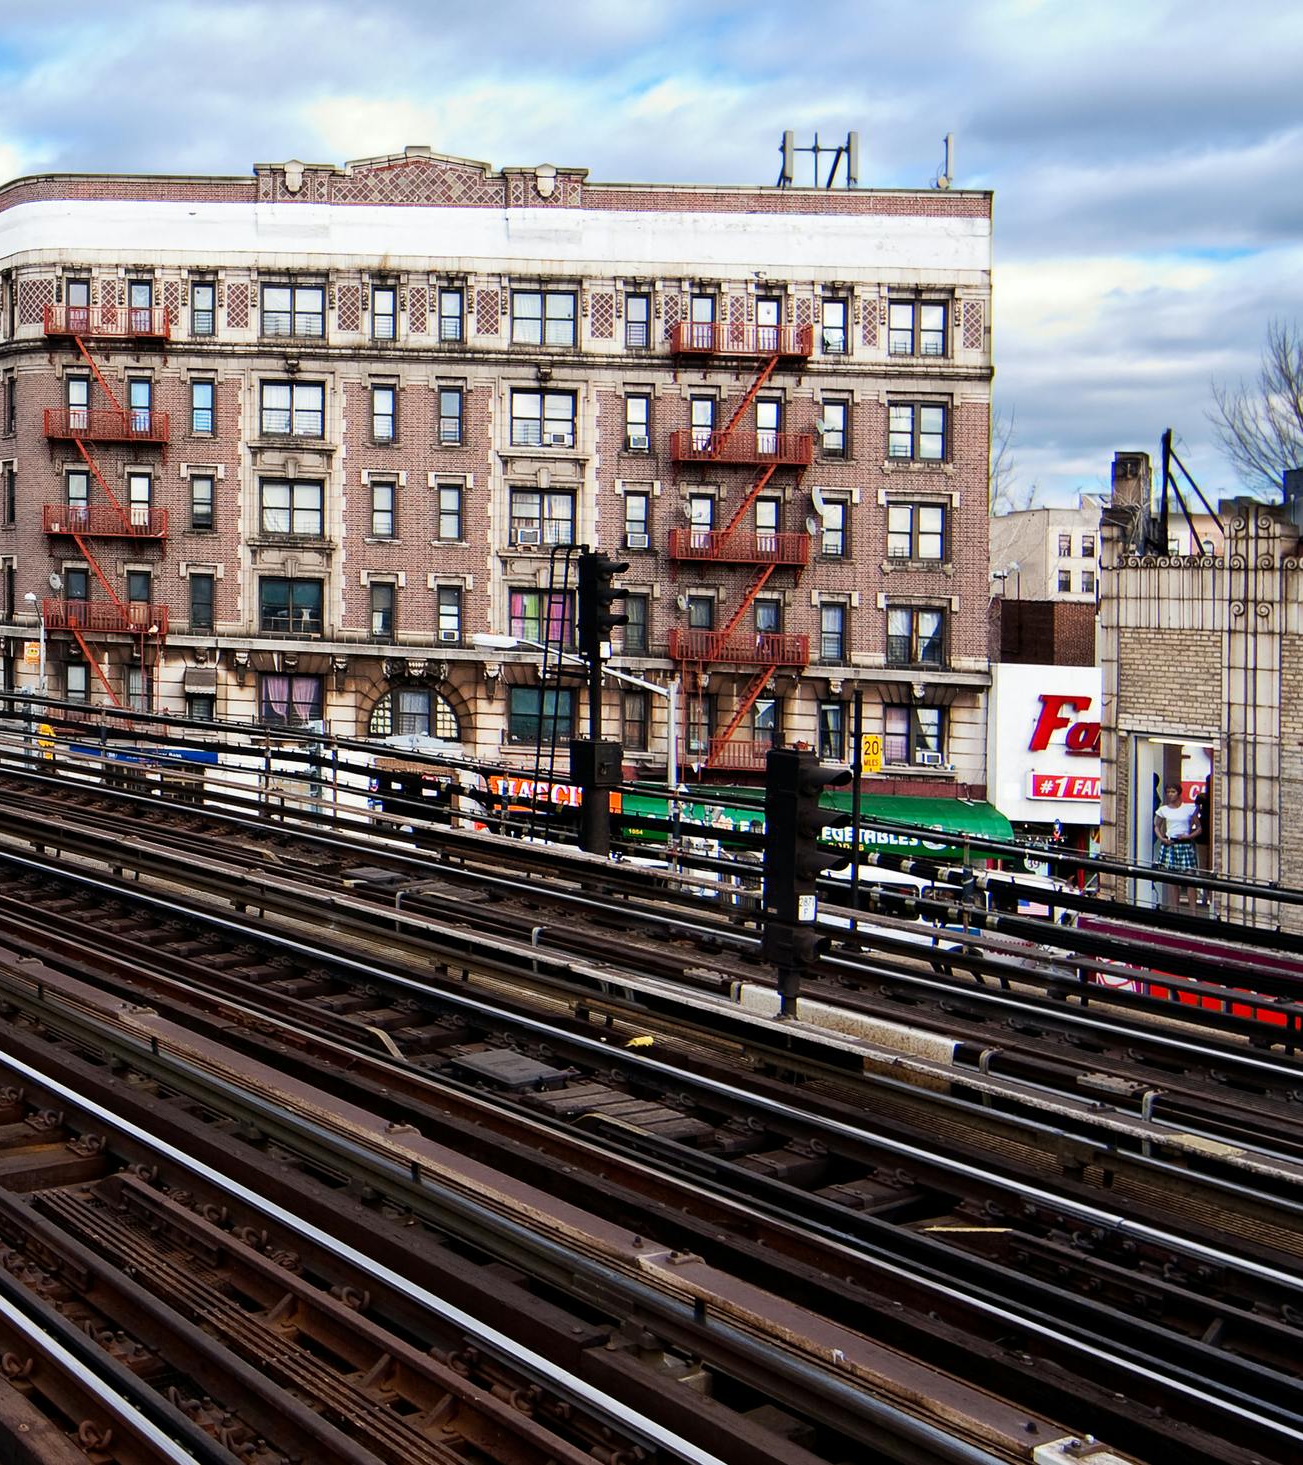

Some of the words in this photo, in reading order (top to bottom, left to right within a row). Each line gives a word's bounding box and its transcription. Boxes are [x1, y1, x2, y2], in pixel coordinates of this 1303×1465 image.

[864, 740, 879, 756] 20
[864, 759, 879, 767] MILES
[1039, 776, 1068, 797] #1
[817, 826, 920, 846] EGETABLES
